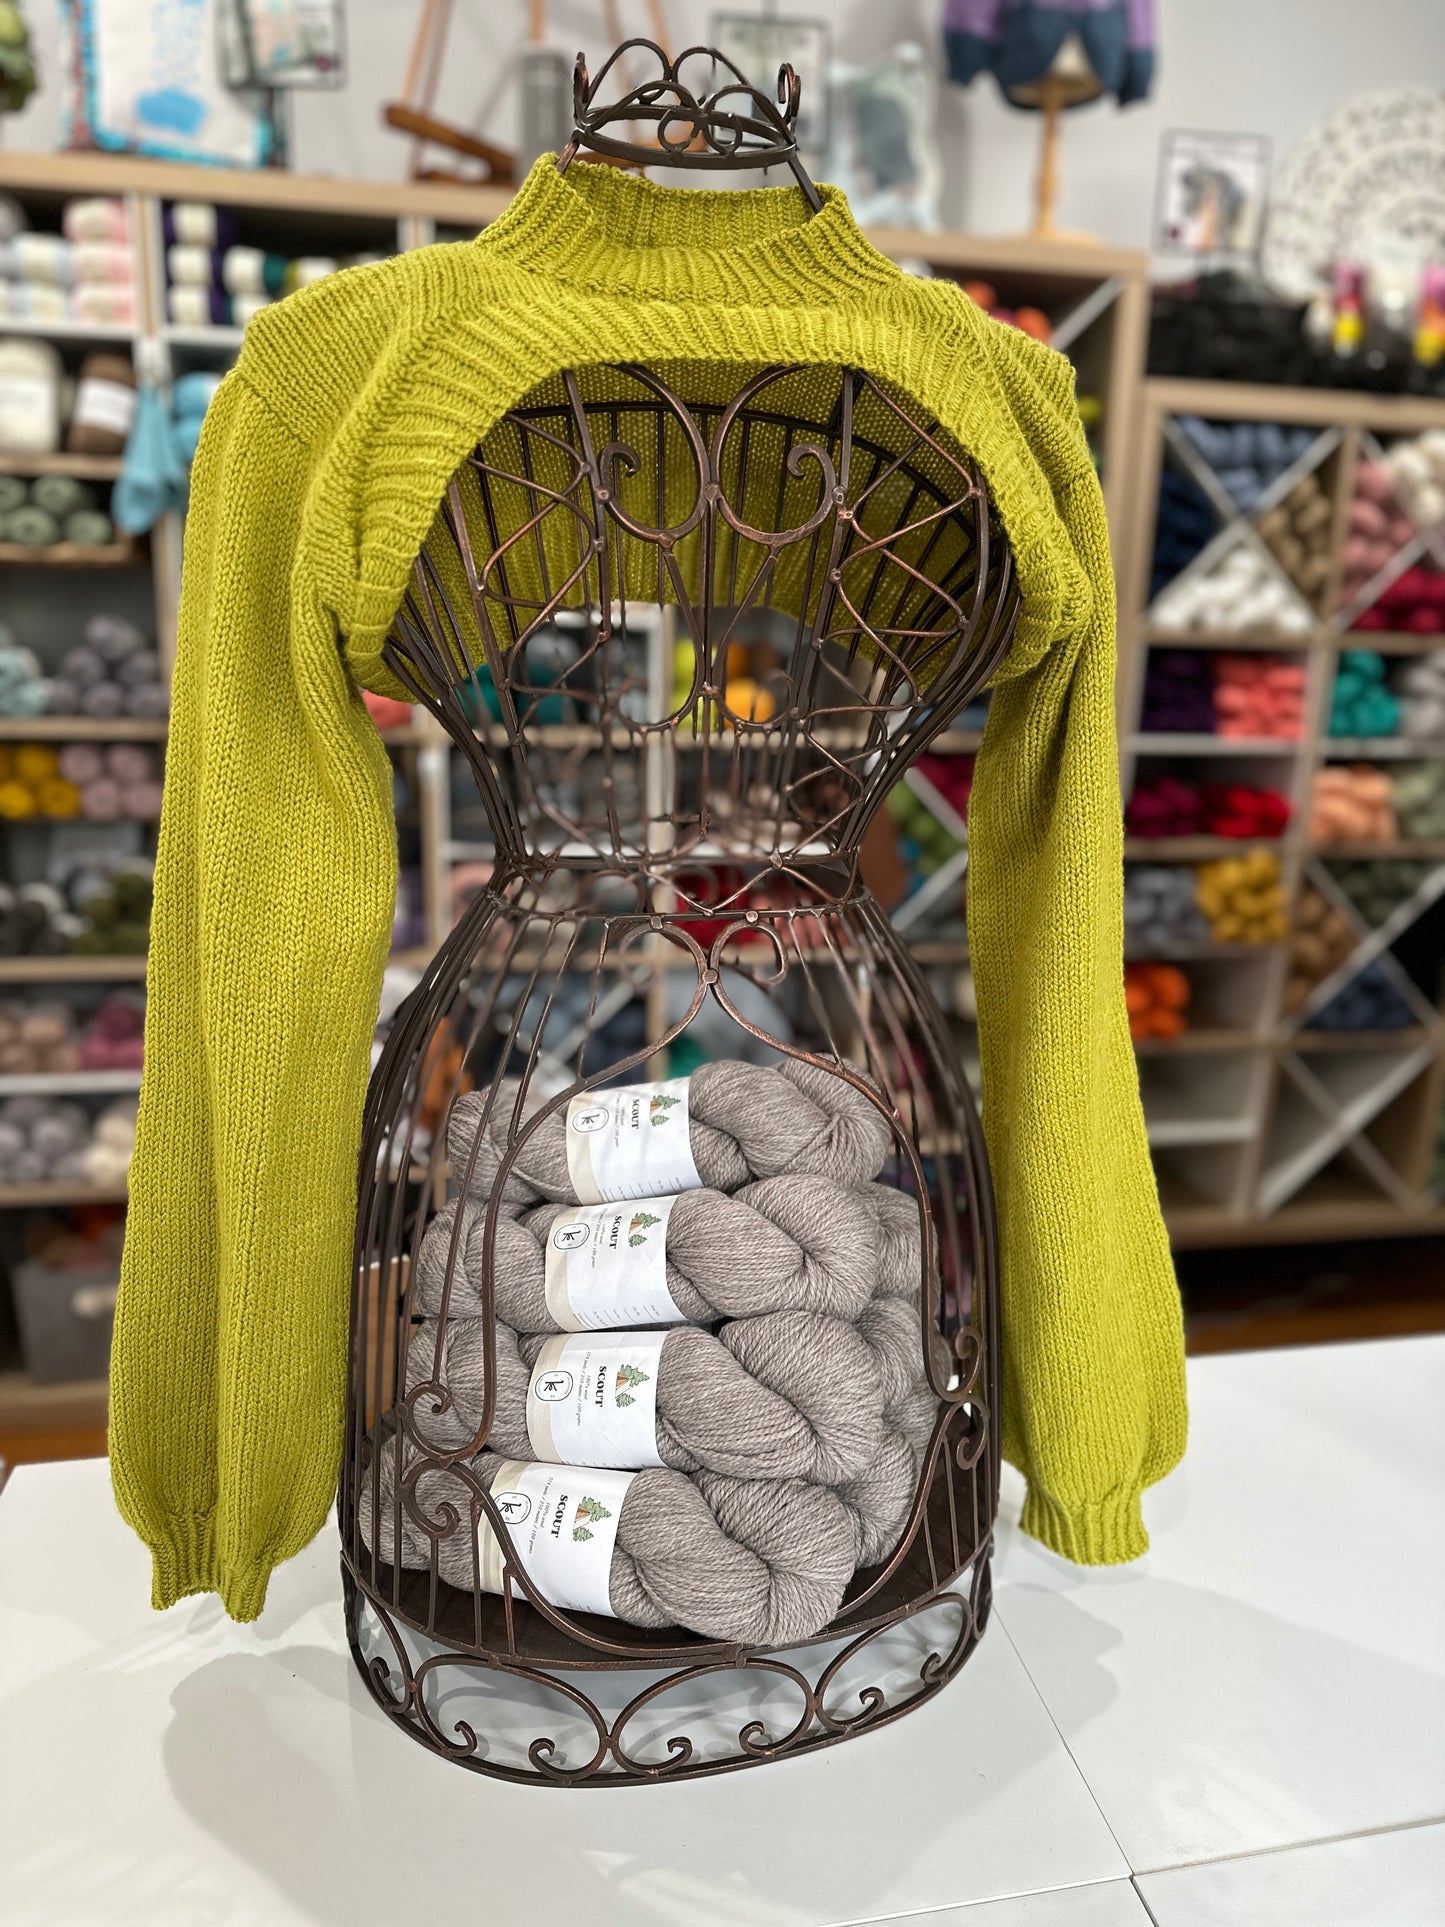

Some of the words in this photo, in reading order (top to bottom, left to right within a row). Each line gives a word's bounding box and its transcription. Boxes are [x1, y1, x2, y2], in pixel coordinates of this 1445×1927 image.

[631, 1098, 640, 1130] SCOUT
[609, 1215, 622, 1250] SCOUT
[595, 1365, 607, 1408] SCOUT
[551, 1494, 568, 1539] SCOUT
